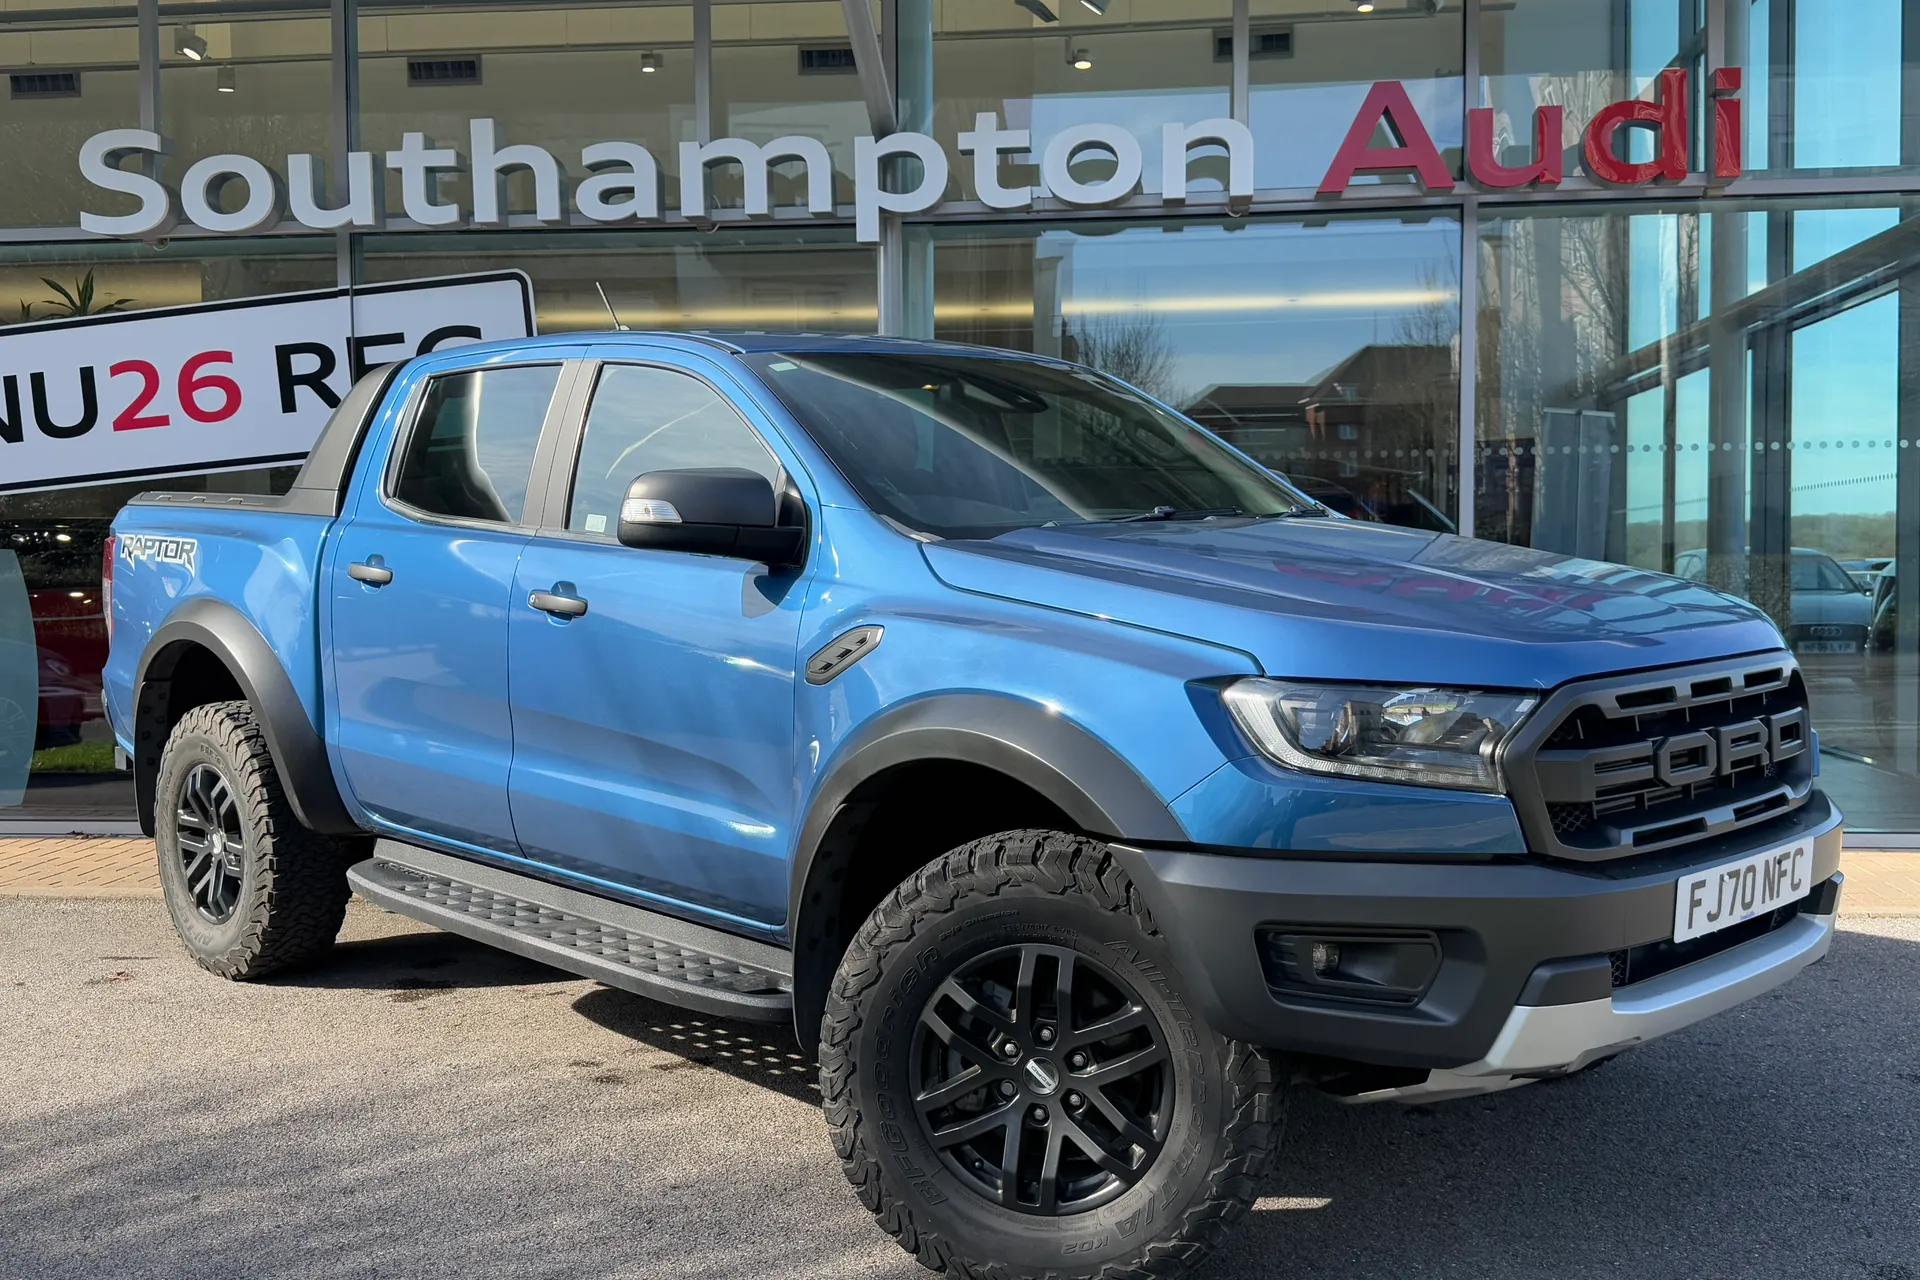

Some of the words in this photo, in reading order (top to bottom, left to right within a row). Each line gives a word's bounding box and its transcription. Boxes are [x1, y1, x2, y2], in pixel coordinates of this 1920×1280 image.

[79, 118, 1254, 242] Southampton
[1317, 67, 1742, 195] Audi
[119, 533, 198, 578] RAPTOR
[1582, 707, 1808, 802] FORD
[1688, 864, 1757, 930] FJ70
[1761, 847, 1804, 904] NFC
[874, 945, 948, 1207] BFGoodrich
[1104, 940, 1206, 1178] All-Terrain
[1115, 1180, 1180, 1239] T/A
